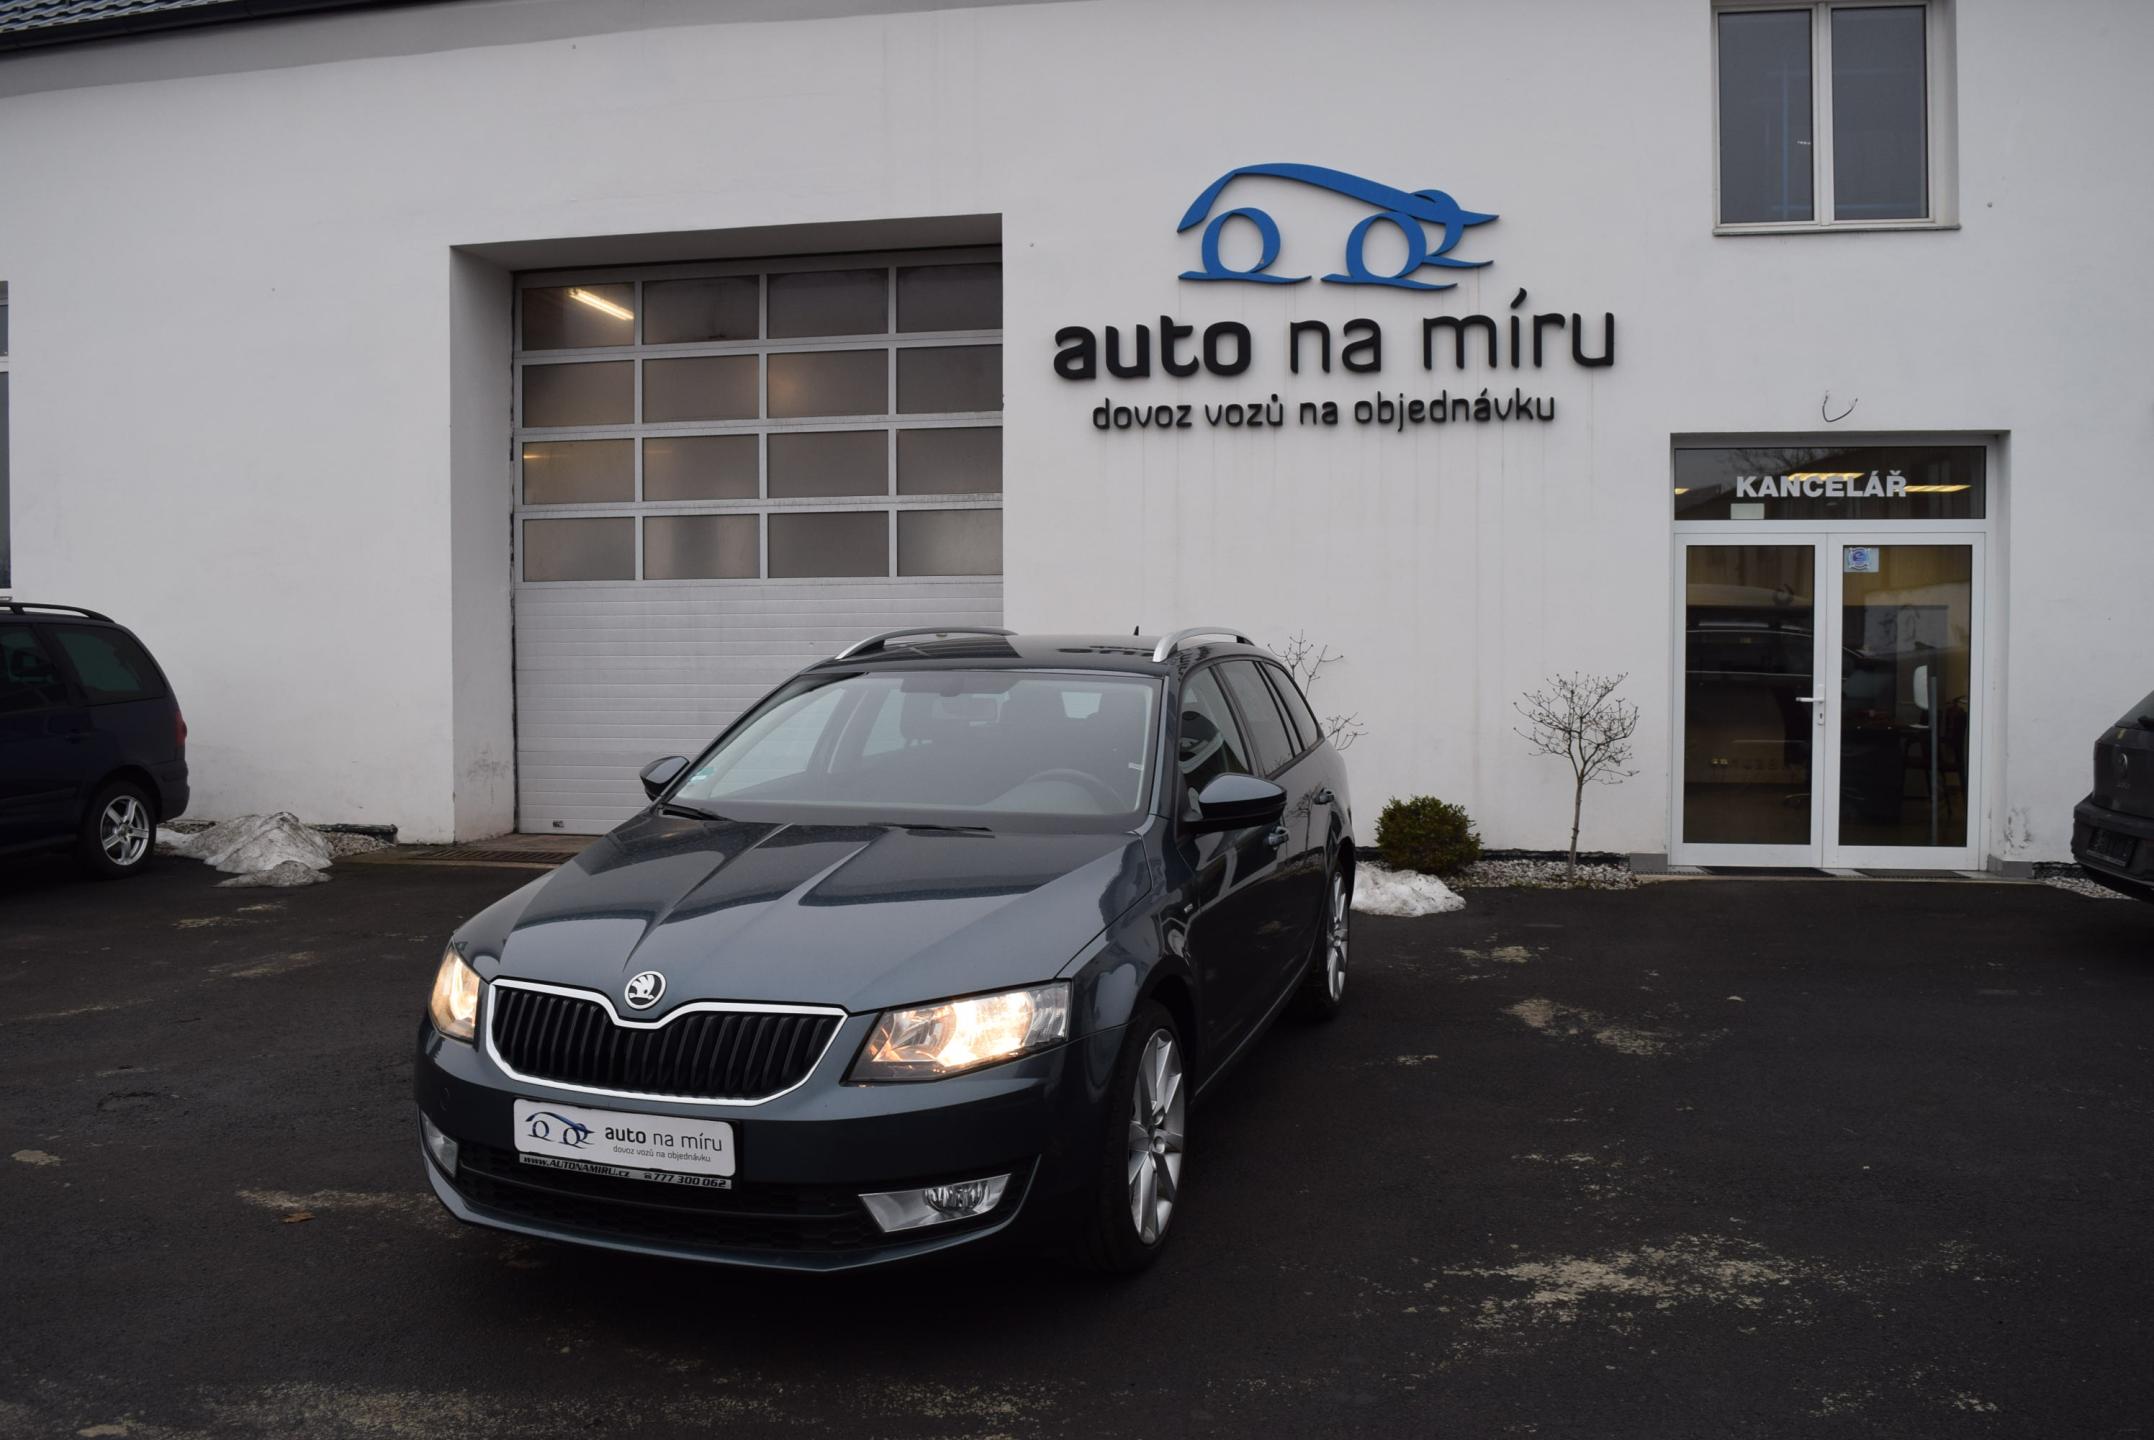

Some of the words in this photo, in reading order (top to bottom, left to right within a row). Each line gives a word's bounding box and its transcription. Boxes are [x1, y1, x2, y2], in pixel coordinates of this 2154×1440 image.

[1053, 315, 1252, 381] auto
[1289, 318, 1382, 375] na
[1422, 287, 1615, 372] míru
[1092, 397, 1193, 433] dovoz
[1204, 393, 1284, 430] vozů
[1299, 401, 1339, 428] na
[1354, 387, 1555, 433] objednávku
[1735, 470, 1908, 498] KANCELÁŘ
[604, 1126, 647, 1145] auto
[653, 1133, 674, 1147] na
[681, 1132, 722, 1152] míru
[654, 1173, 675, 1183] 777
[677, 1175, 700, 1186] 300
[702, 1179, 727, 1188] 062
